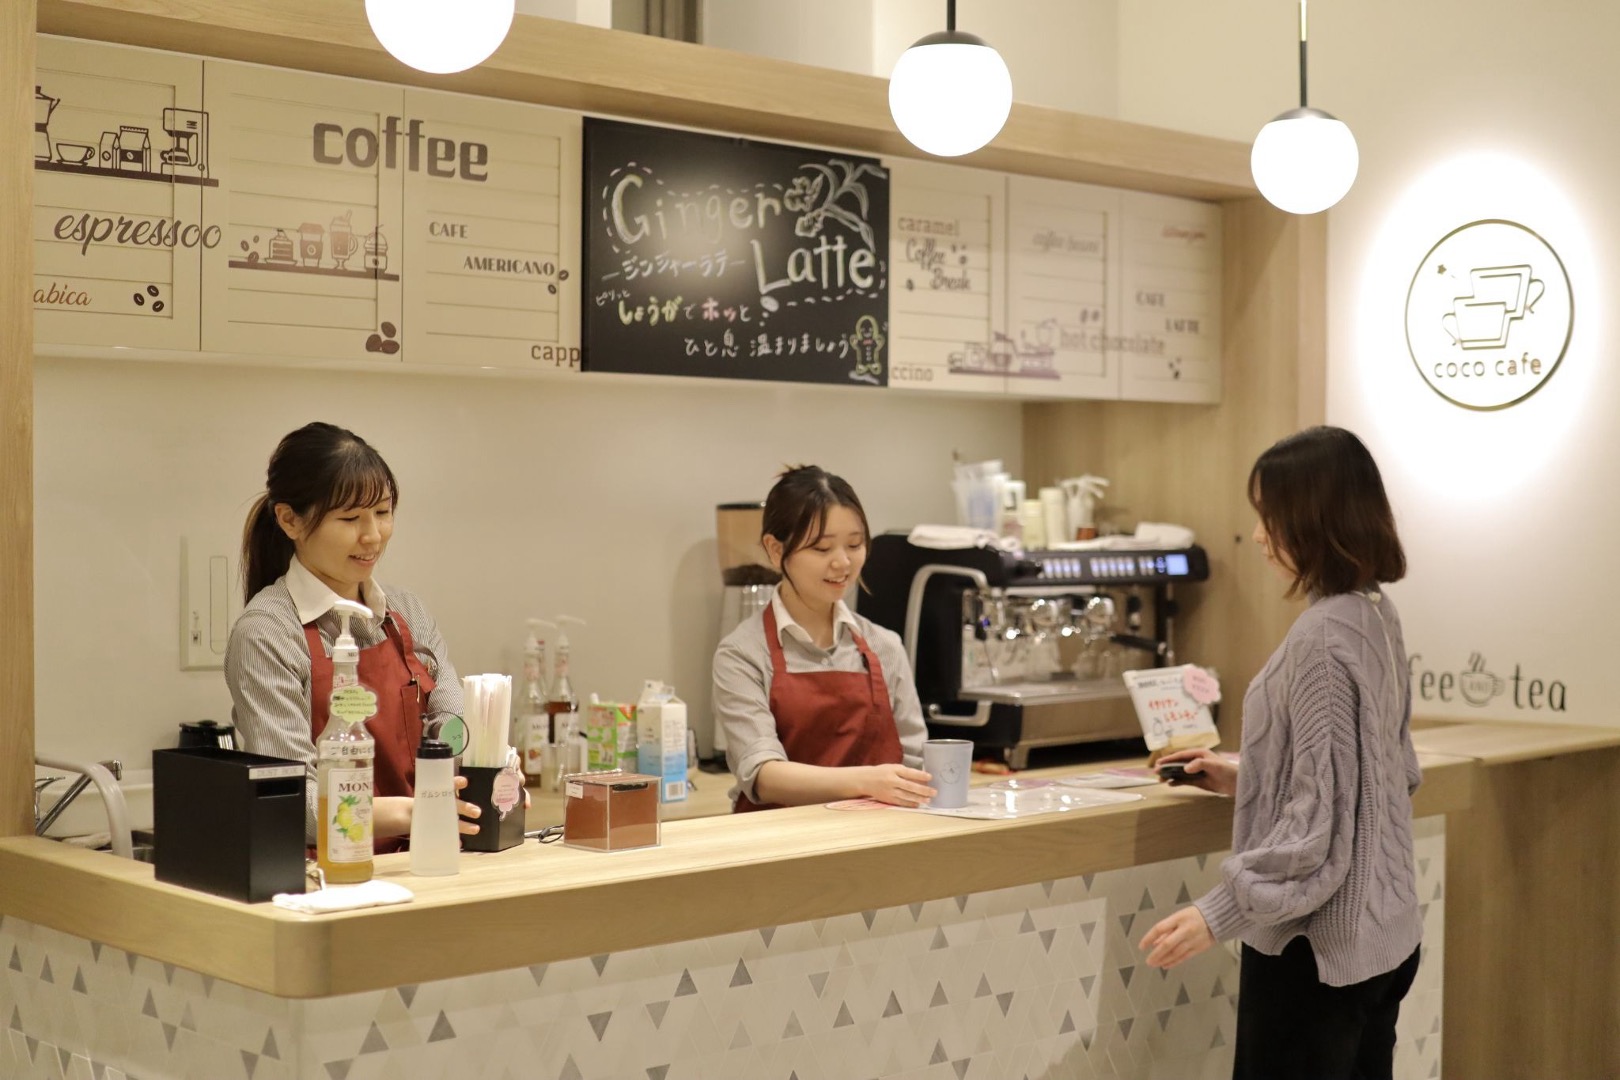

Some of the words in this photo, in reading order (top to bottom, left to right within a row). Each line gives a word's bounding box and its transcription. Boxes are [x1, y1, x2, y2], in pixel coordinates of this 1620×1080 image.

[312, 115, 488, 182] coffee
[612, 174, 781, 245] Ginger
[897, 217, 960, 237] caramel
[53, 212, 222, 256] espressoo
[429, 221, 468, 239] CAFE
[463, 255, 555, 276] AMERICANO
[750, 235, 876, 294] Latte
[33, 282, 92, 306] abica
[1434, 362, 1485, 378] coco
[1495, 352, 1542, 375] cafe
[1510, 663, 1566, 712] tea
